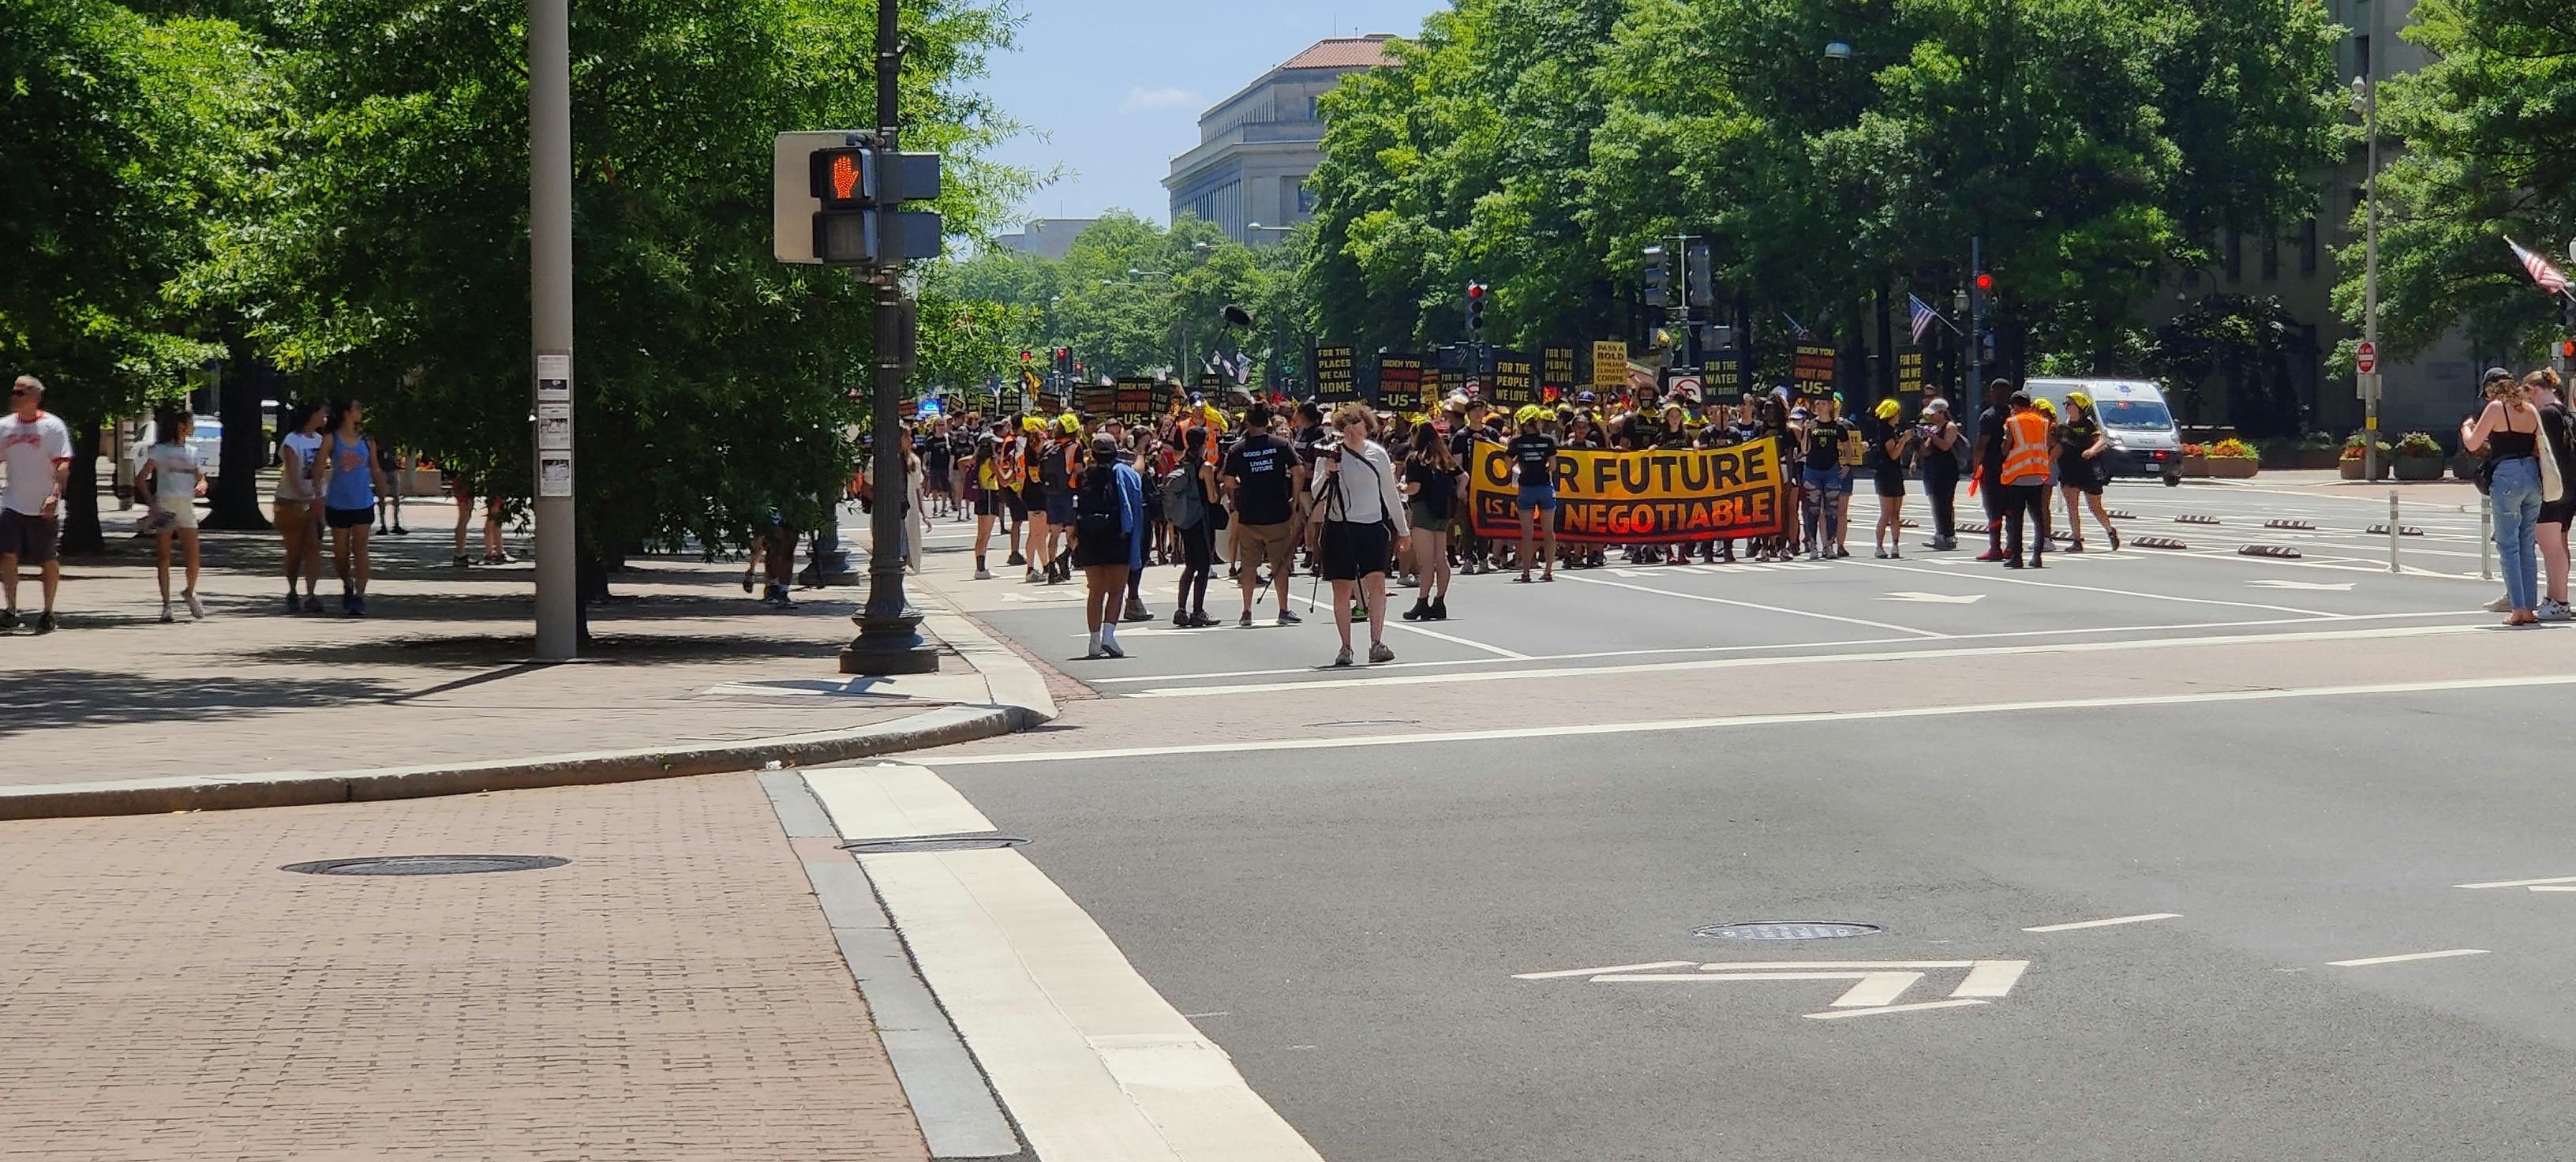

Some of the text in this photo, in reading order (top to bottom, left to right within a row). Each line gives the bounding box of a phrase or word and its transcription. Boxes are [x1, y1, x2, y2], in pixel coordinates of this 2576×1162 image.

[1318, 349, 1333, 358] FOR
[1319, 359, 1352, 369] PLACES
[1497, 362, 1531, 373] FOR THE
[1545, 361, 1572, 370] PEOPLE
[1705, 361, 1738, 371] FOR THE
[1333, 370, 1352, 379] CALL
[1705, 373, 1737, 384] WATER
[1320, 381, 1353, 393] HOME
[1381, 380, 1418, 392] FIGHT FOR
[1496, 376, 1530, 388] PEOPLE
[1496, 389, 1529, 402] WE LOVE
[1485, 450, 1579, 493] OR
[1593, 446, 1769, 493] FUTURE
[1485, 498, 1503, 515] IS
[1564, 493, 1770, 534] NEGOTIABLE
